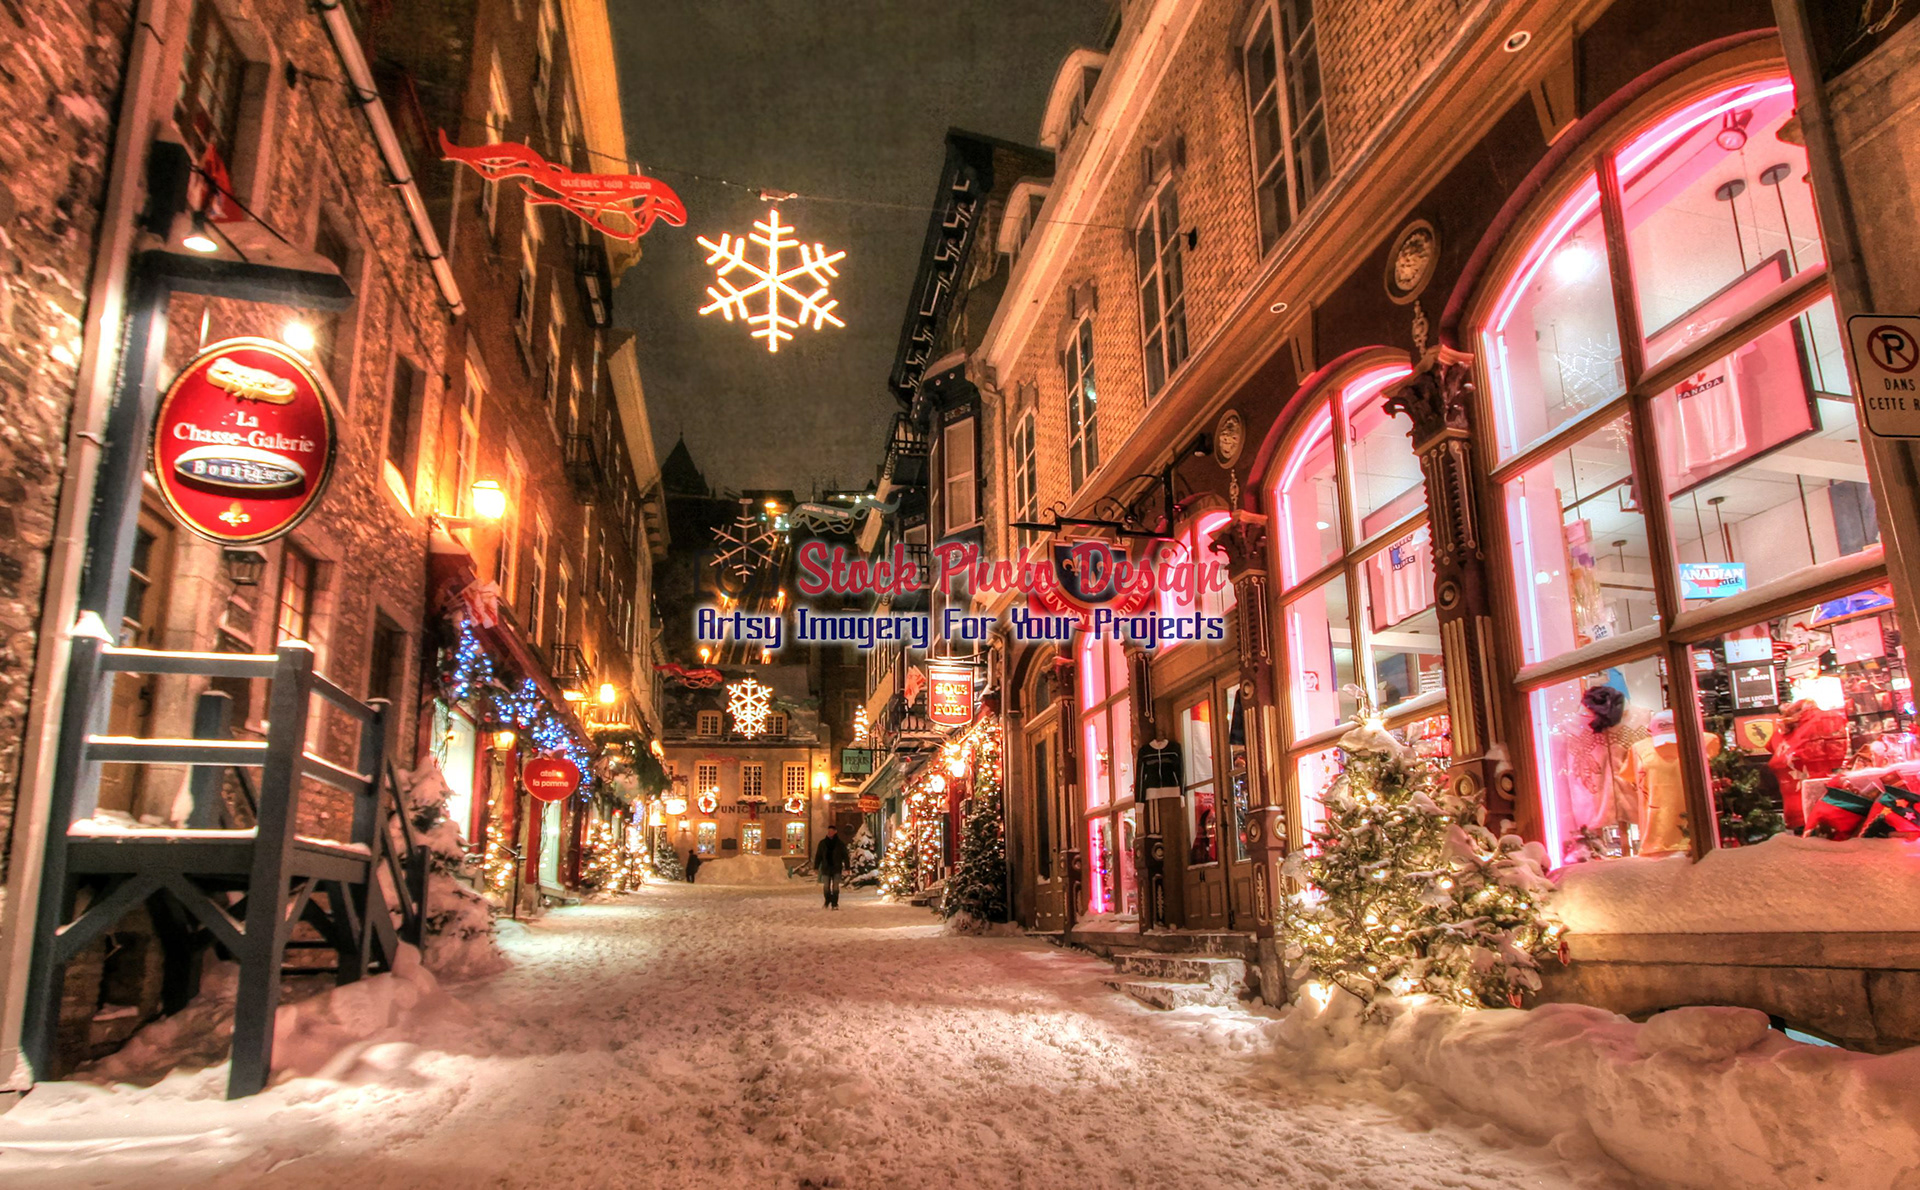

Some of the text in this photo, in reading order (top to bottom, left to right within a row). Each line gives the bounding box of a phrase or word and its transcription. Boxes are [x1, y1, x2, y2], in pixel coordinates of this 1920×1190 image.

[629, 181, 651, 190] 2008
[1881, 334, 1904, 364] P
[1884, 378, 1915, 391] DANS
[1869, 397, 1905, 410] CETTE
[236, 411, 259, 427] La
[173, 422, 316, 452] Chasse-Galerie
[1681, 568, 1744, 580] ANADIAN
[935, 682, 968, 695] SOUS
[934, 703, 970, 716] FORT
[532, 779, 540, 787] la
